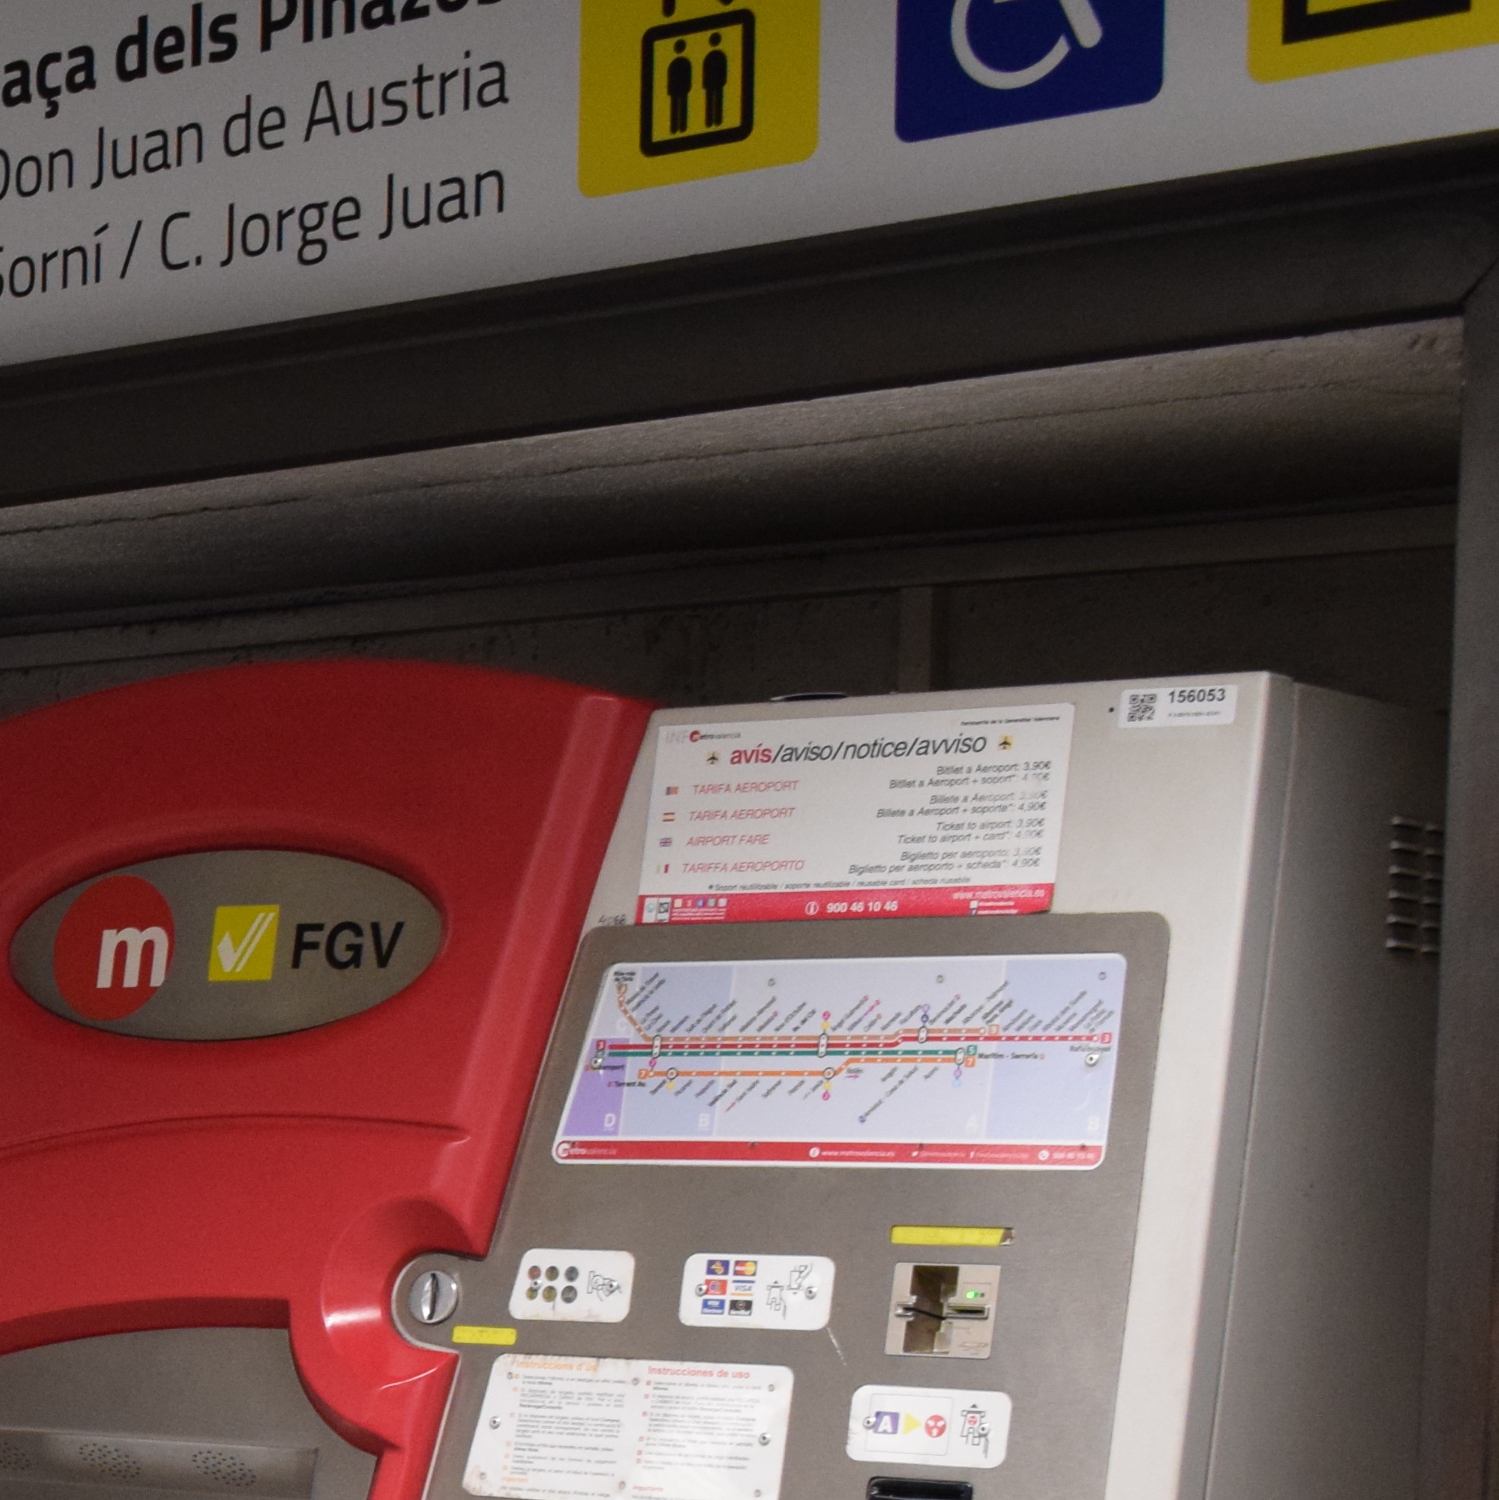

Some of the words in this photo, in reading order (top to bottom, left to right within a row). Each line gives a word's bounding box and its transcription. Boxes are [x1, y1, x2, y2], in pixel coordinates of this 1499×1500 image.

[115, 14, 236, 84] dels
[91, 121, 202, 191] Juan
[224, 94, 285, 160] de
[304, 51, 508, 142] Austria
[120, 219, 142, 279] /
[160, 215, 201, 272] C.
[222, 191, 361, 267] Jorge
[379, 168, 505, 241] Juan
[1169, 688, 1226, 703] 156053
[735, 781, 798, 793] AEROPORT
[826, 902, 846, 913] 900
[850, 902, 864, 912] 46
[868, 901, 880, 911] 10
[96, 926, 169, 989] m
[290, 920, 405, 970] FGV
[648, 1366, 713, 1377] Instrucciones
[717, 1369, 728, 1378] de
